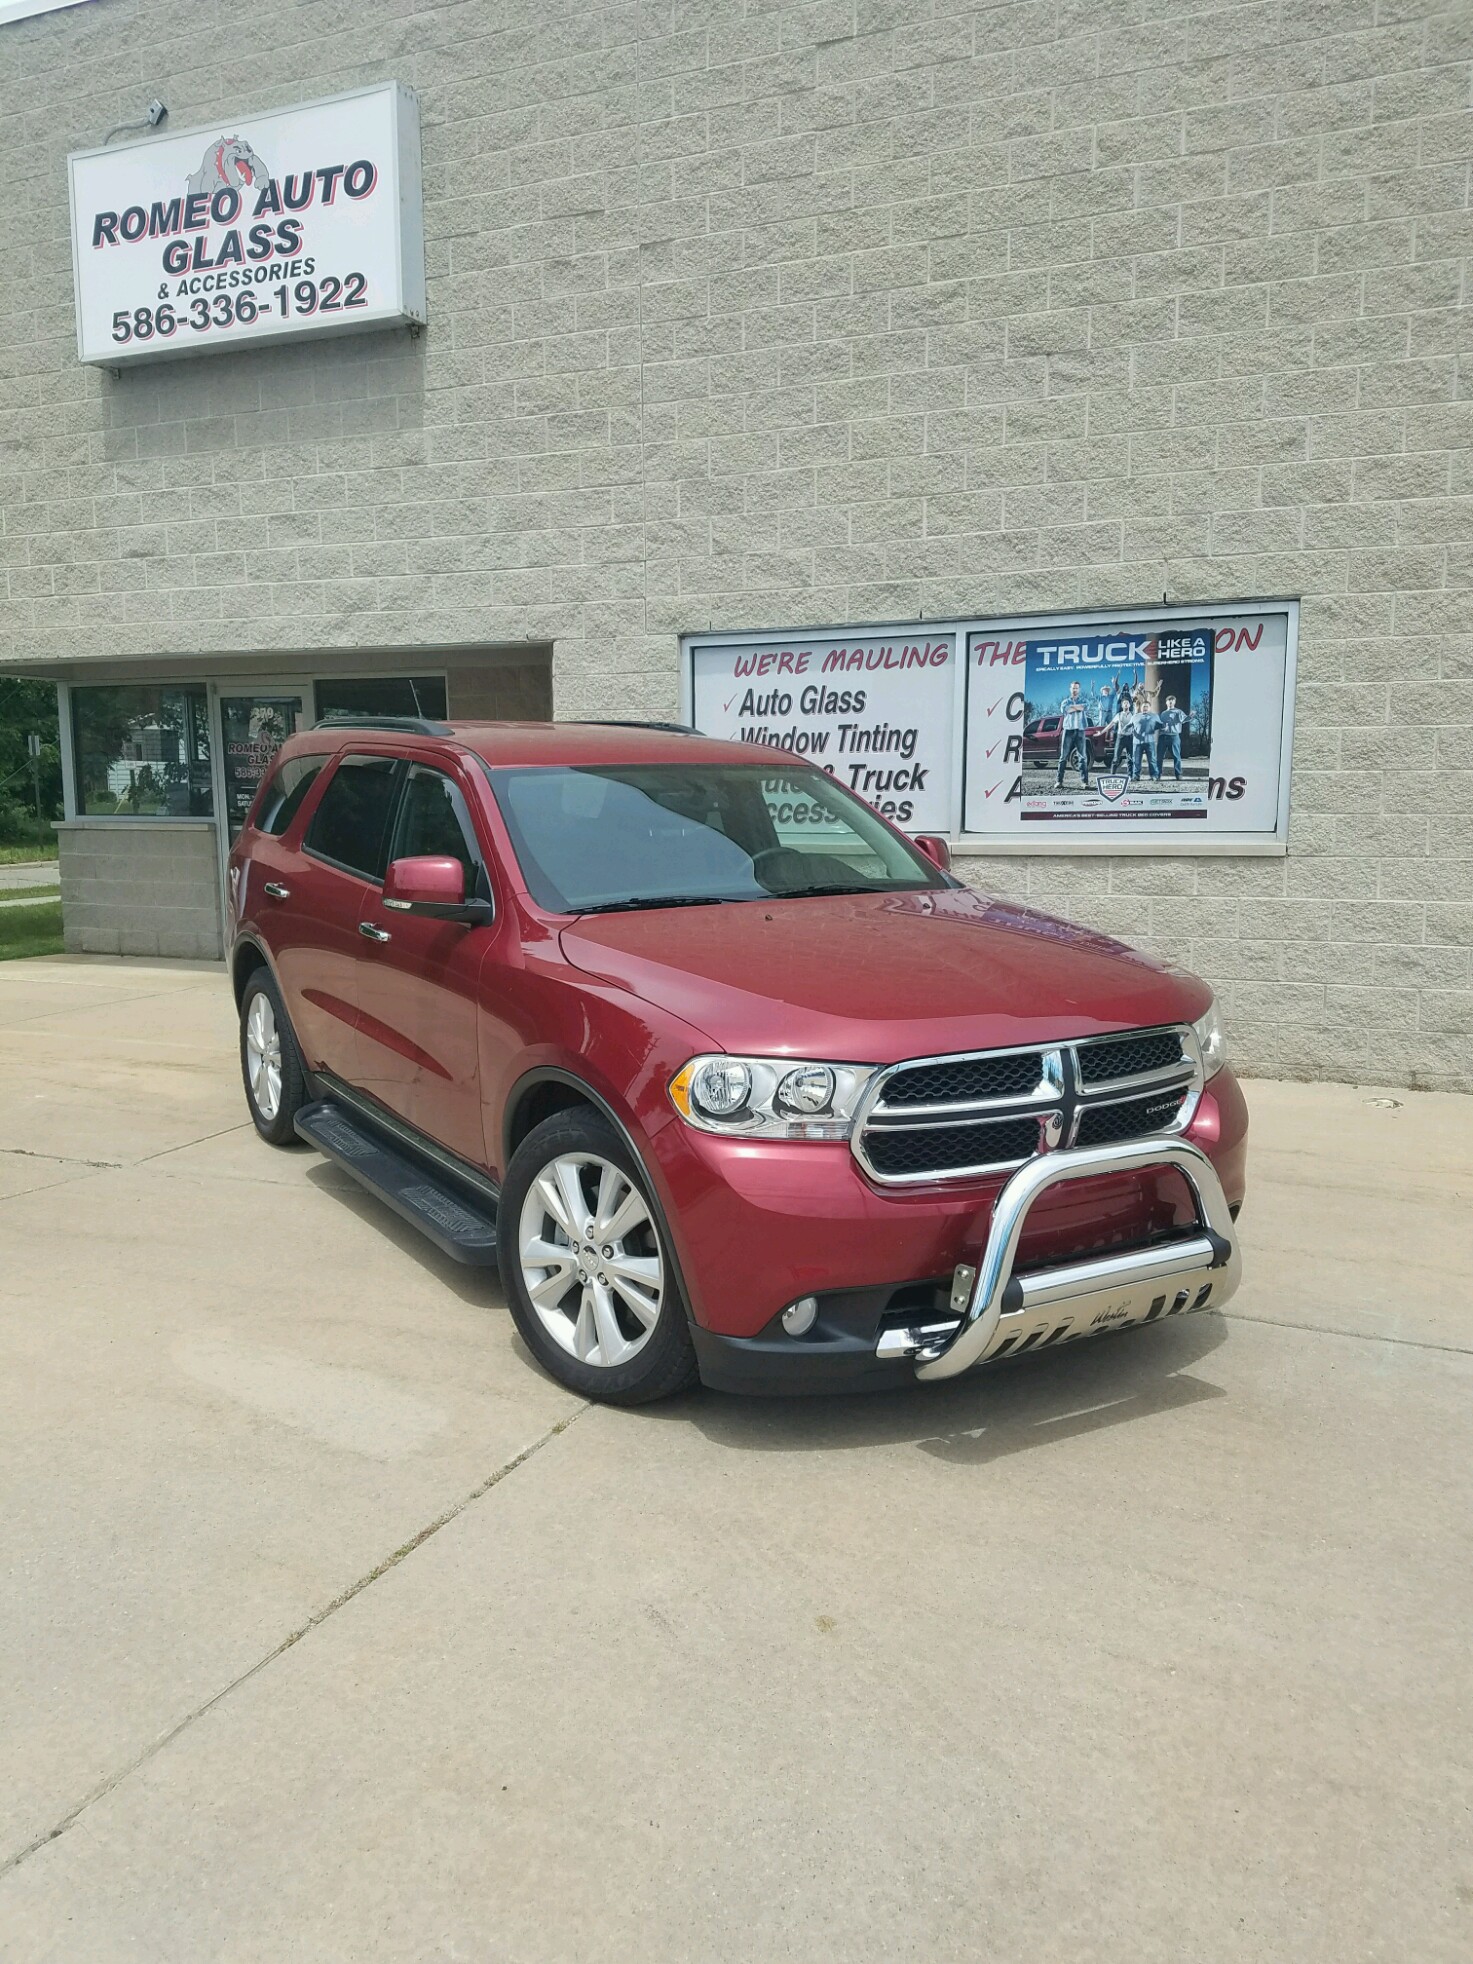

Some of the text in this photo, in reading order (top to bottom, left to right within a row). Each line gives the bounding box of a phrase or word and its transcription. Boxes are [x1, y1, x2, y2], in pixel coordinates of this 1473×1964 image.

[92, 159, 378, 249] ROMEO AUTO
[162, 219, 304, 275] GLASS
[157, 257, 316, 299] & ACCESSORIES
[111, 272, 368, 344] 586-336-1922
[1036, 640, 1152, 665] TRUCK
[1157, 637, 1206, 649] LIKE A
[1157, 646, 1206, 659] HERO
[733, 641, 1026, 678] WE'RE MAULING THE
[738, 685, 867, 717] Auto Glass
[228, 743, 270, 754] ROMEO
[740, 723, 918, 759] Window Tinting
[848, 762, 930, 792] Truck
[1146, 1099, 1183, 1114] DODGE
